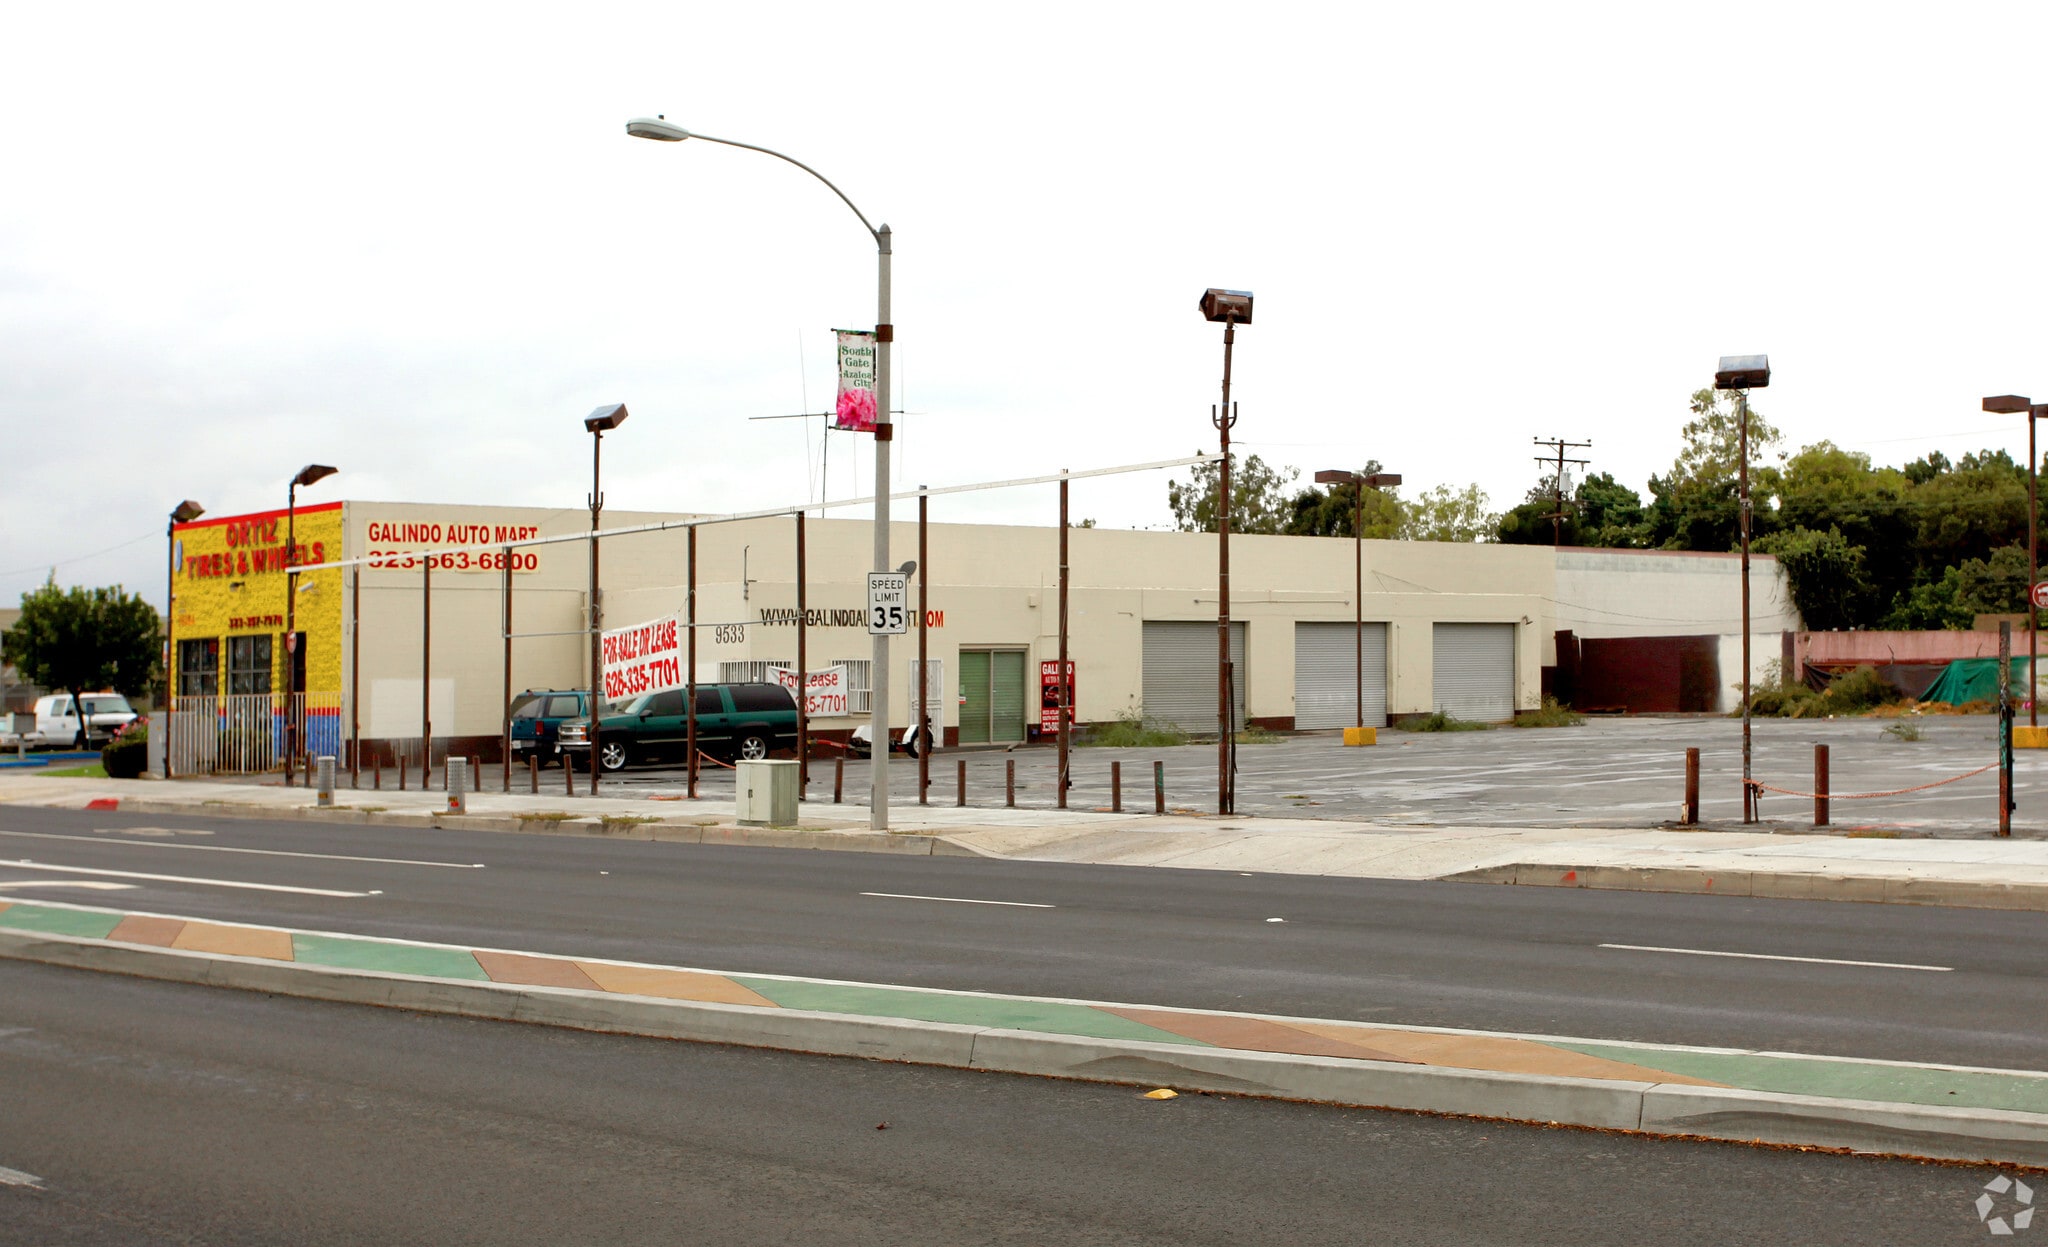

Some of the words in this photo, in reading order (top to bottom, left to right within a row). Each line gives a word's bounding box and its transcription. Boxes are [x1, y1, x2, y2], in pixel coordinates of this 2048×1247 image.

[842, 346, 872, 356] South
[845, 357, 870, 367] Gate
[226, 518, 278, 548] ORTIZ
[368, 523, 442, 543] GALINDO
[446, 525, 490, 544] AUTO
[495, 526, 538, 543] MART
[186, 552, 233, 579] TIRES
[237, 550, 249, 575] &
[871, 580, 904, 590] SPEED
[875, 592, 900, 602] LIMIT
[873, 607, 903, 628] 35
[603, 636, 618, 666] FOR
[618, 630, 638, 662] SALE
[639, 627, 650, 657] OR
[651, 619, 678, 654] LEASE
[715, 624, 745, 644] 9533
[605, 656, 680, 699] 626-335-7701
[1042, 663, 1073, 675] GALIO
